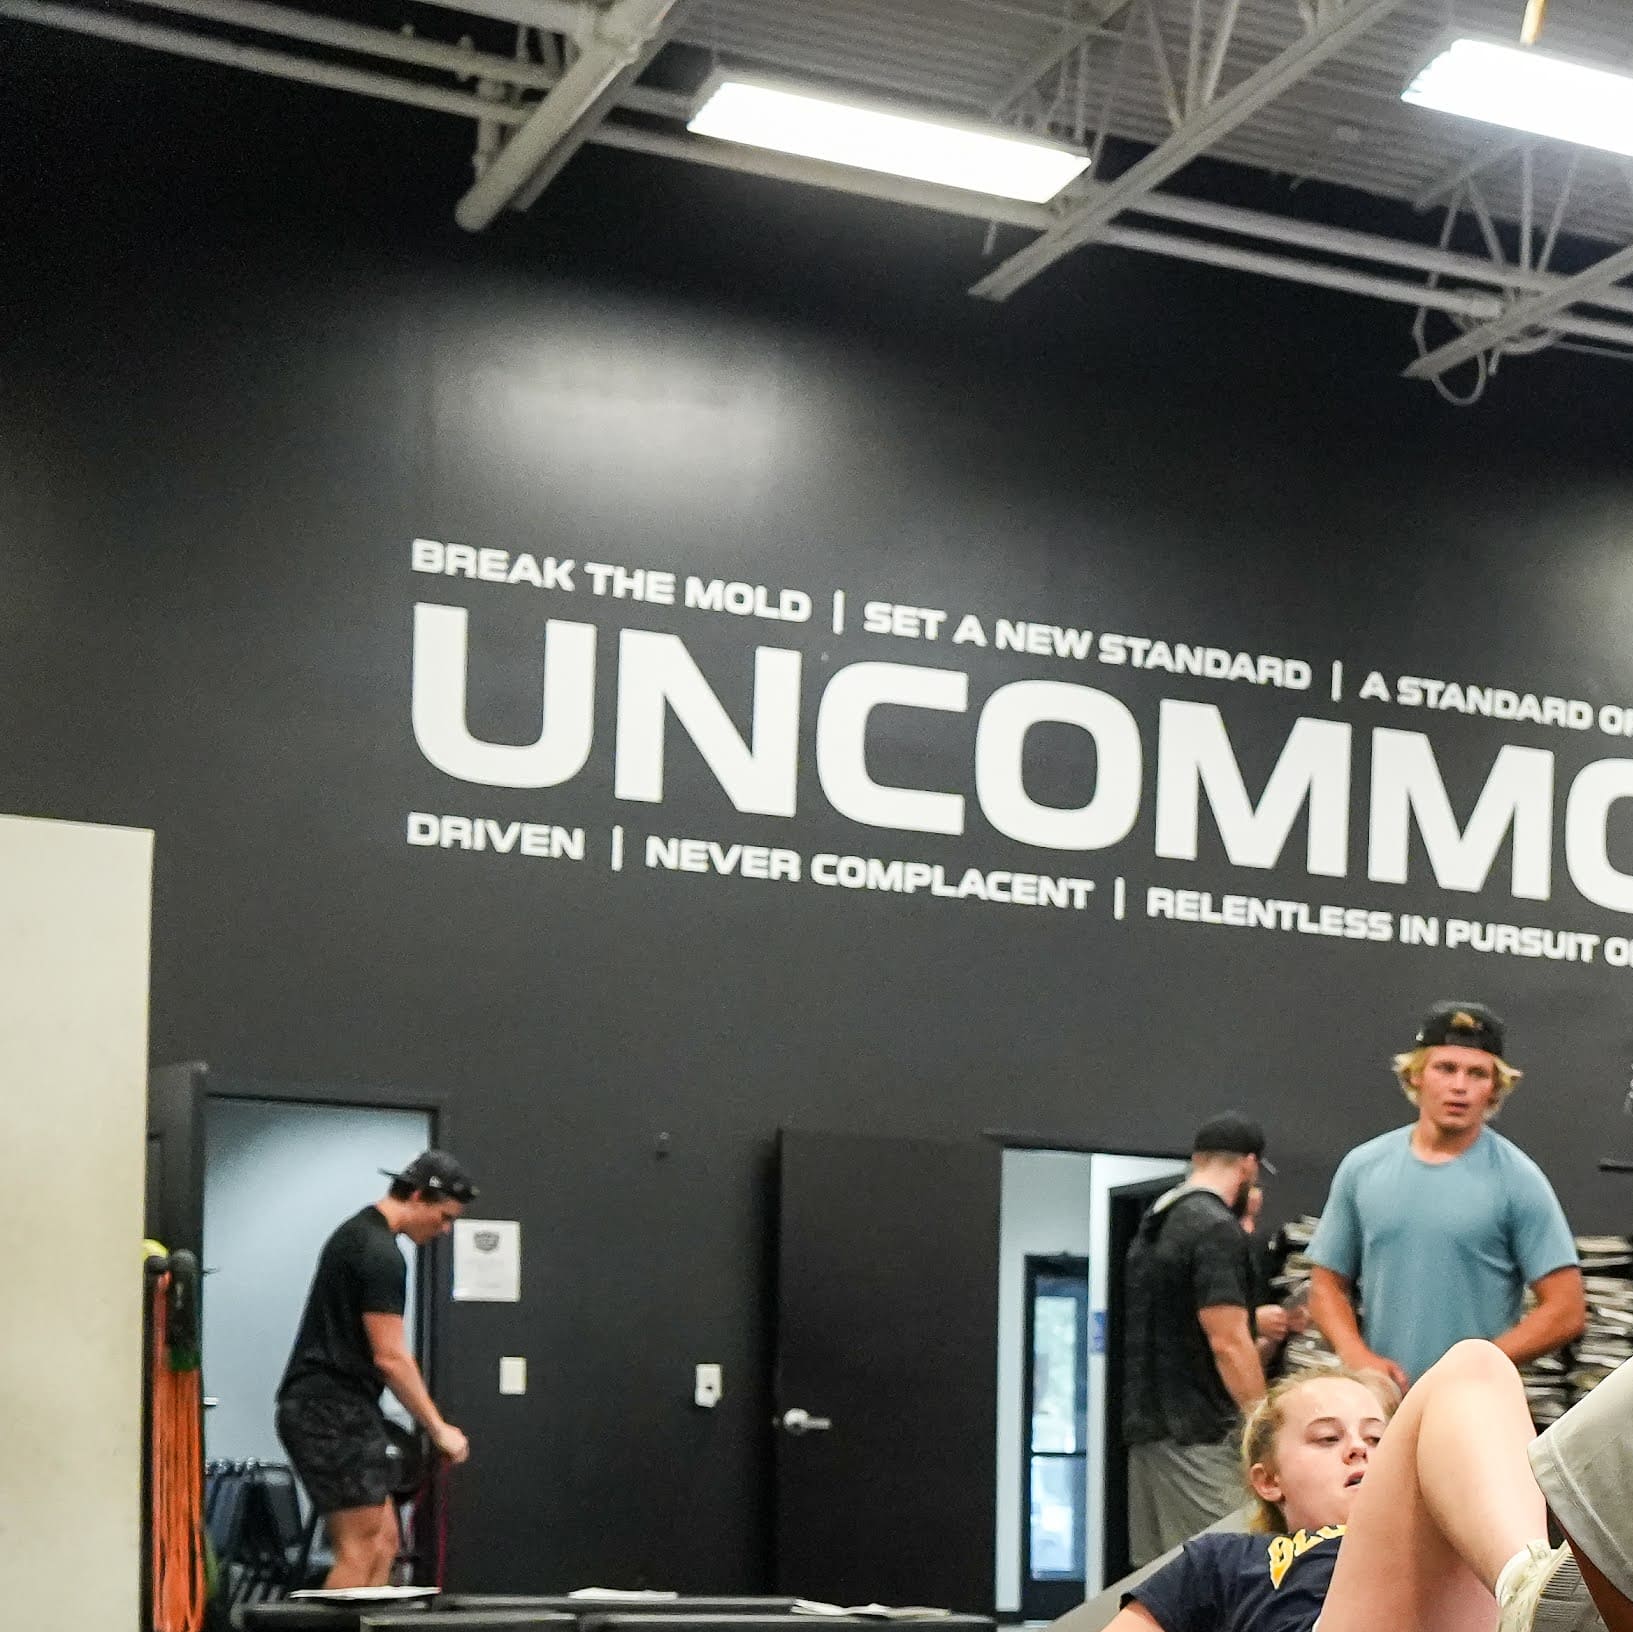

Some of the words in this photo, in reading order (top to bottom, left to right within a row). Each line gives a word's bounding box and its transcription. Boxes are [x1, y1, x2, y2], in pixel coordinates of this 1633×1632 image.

[411, 538, 575, 592] BREAK
[585, 562, 675, 605] THE
[684, 577, 813, 623] MOLD
[863, 602, 947, 642] SET
[953, 614, 987, 648] A
[996, 620, 1091, 661] NEW
[1098, 633, 1312, 691] STANDARD
[1360, 671, 1393, 701] A
[1397, 675, 1593, 731] STANDARD
[407, 812, 585, 861] DRIVEN
[645, 836, 800, 883] NEVER
[811, 853, 1094, 910] COMPLACENT
[1147, 886, 1393, 942] RELENTLESS
[1400, 915, 1441, 946] IN
[1446, 919, 1599, 964] PURSUIT
